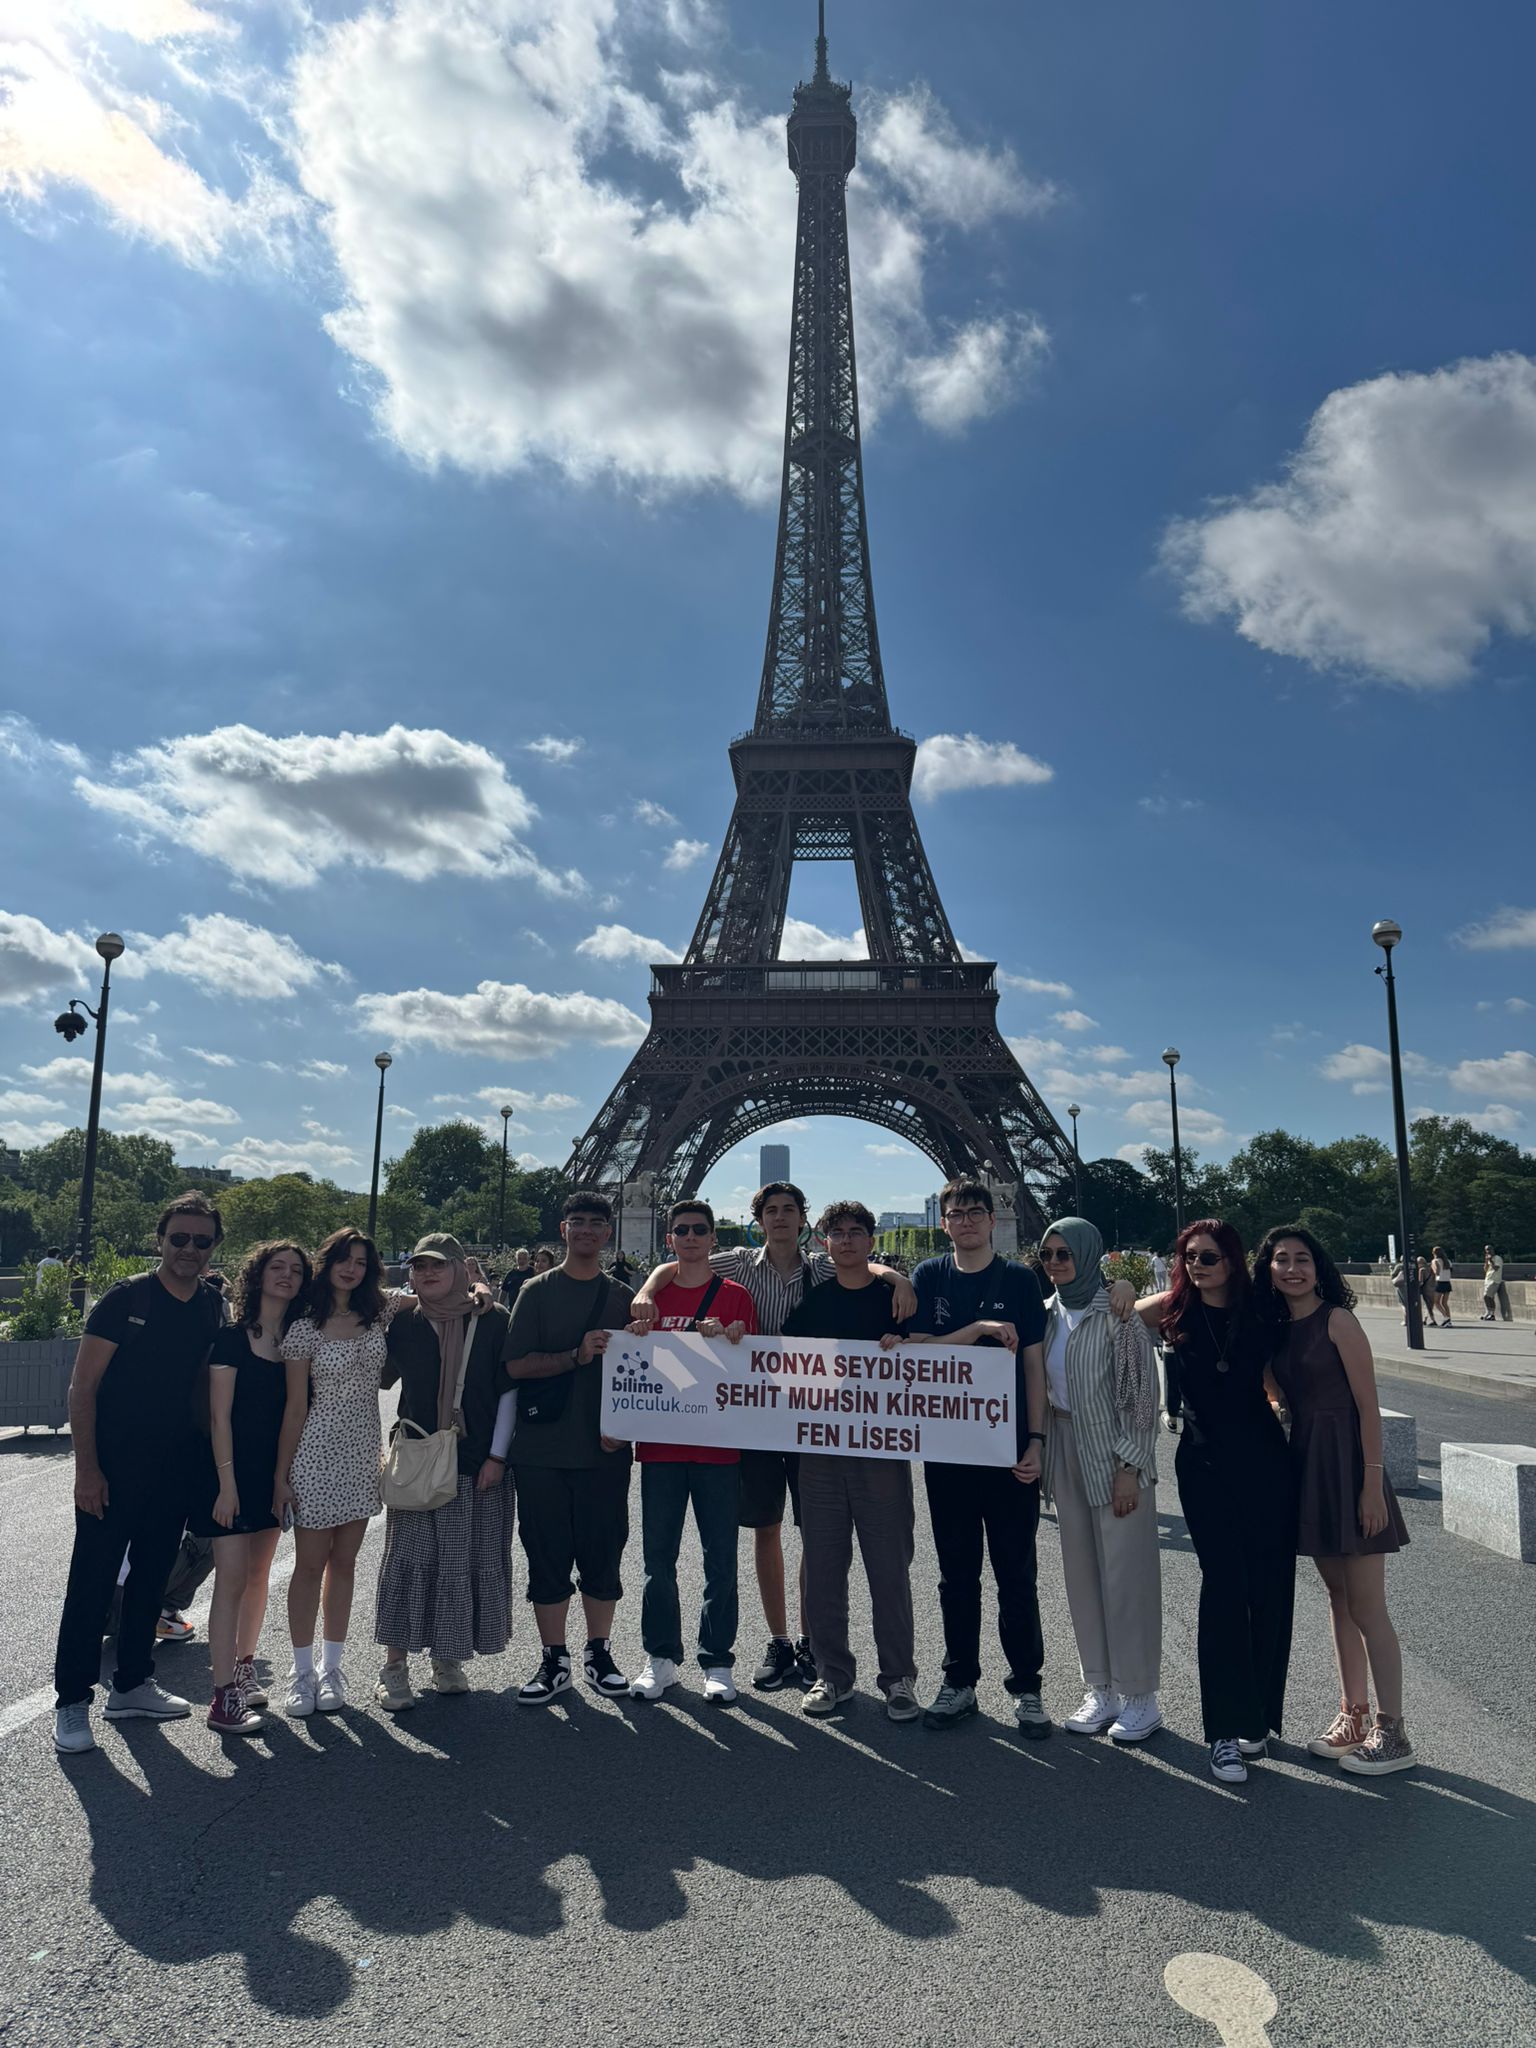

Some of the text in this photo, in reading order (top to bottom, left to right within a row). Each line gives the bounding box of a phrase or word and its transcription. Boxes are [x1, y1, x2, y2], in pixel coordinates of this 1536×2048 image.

[612, 1376, 664, 1395] bilime
[750, 1350, 974, 1388] KONYA SEYDİŞEHİR
[611, 1395, 708, 1415] yolculuk.com
[715, 1380, 1009, 1429] ŞEHİT MUHSİN KİREMİTÇİ
[797, 1420, 921, 1453] FEN LİSESİ
